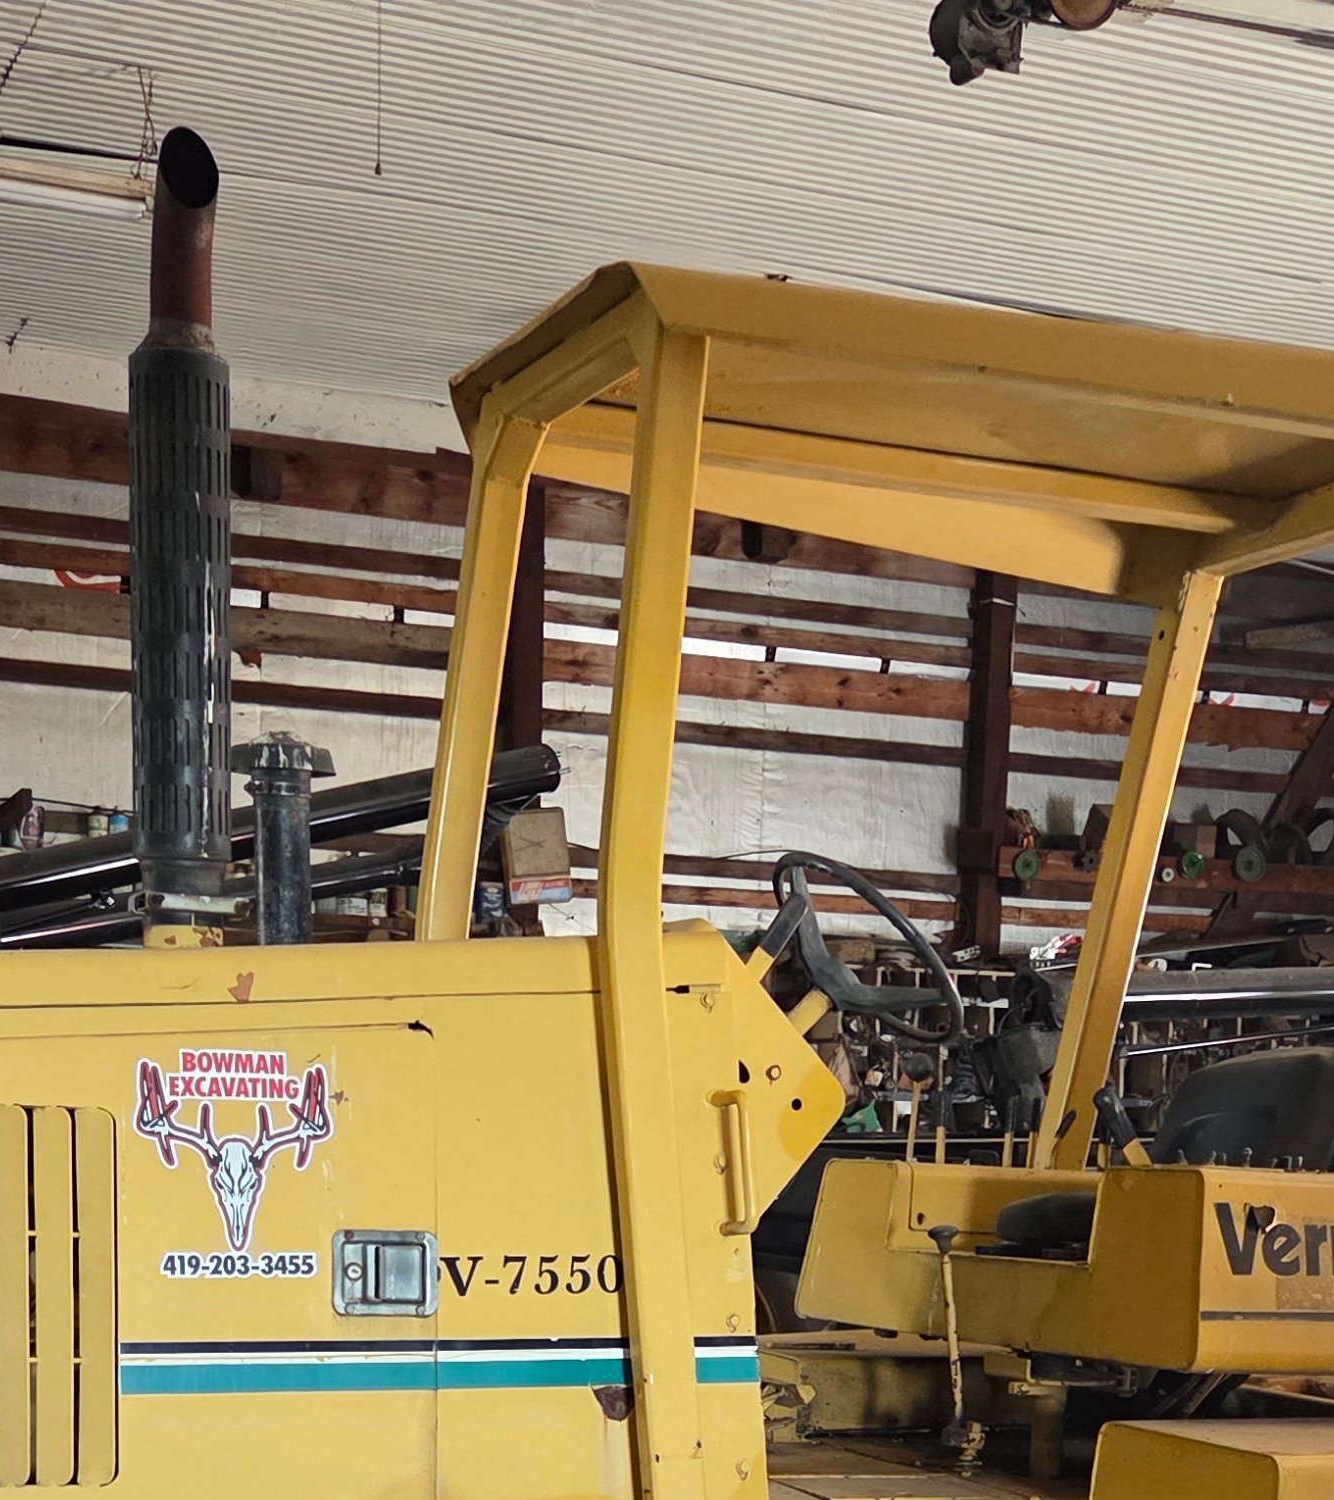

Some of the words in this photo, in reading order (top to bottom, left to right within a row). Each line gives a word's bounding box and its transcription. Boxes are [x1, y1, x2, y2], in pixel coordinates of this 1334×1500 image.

[182, 1052, 285, 1074] BOWMAN
[169, 1076, 299, 1099] EXCAVATING
[163, 1255, 314, 1275] 419-203-3455
[439, 1254, 625, 1297] V-7550
